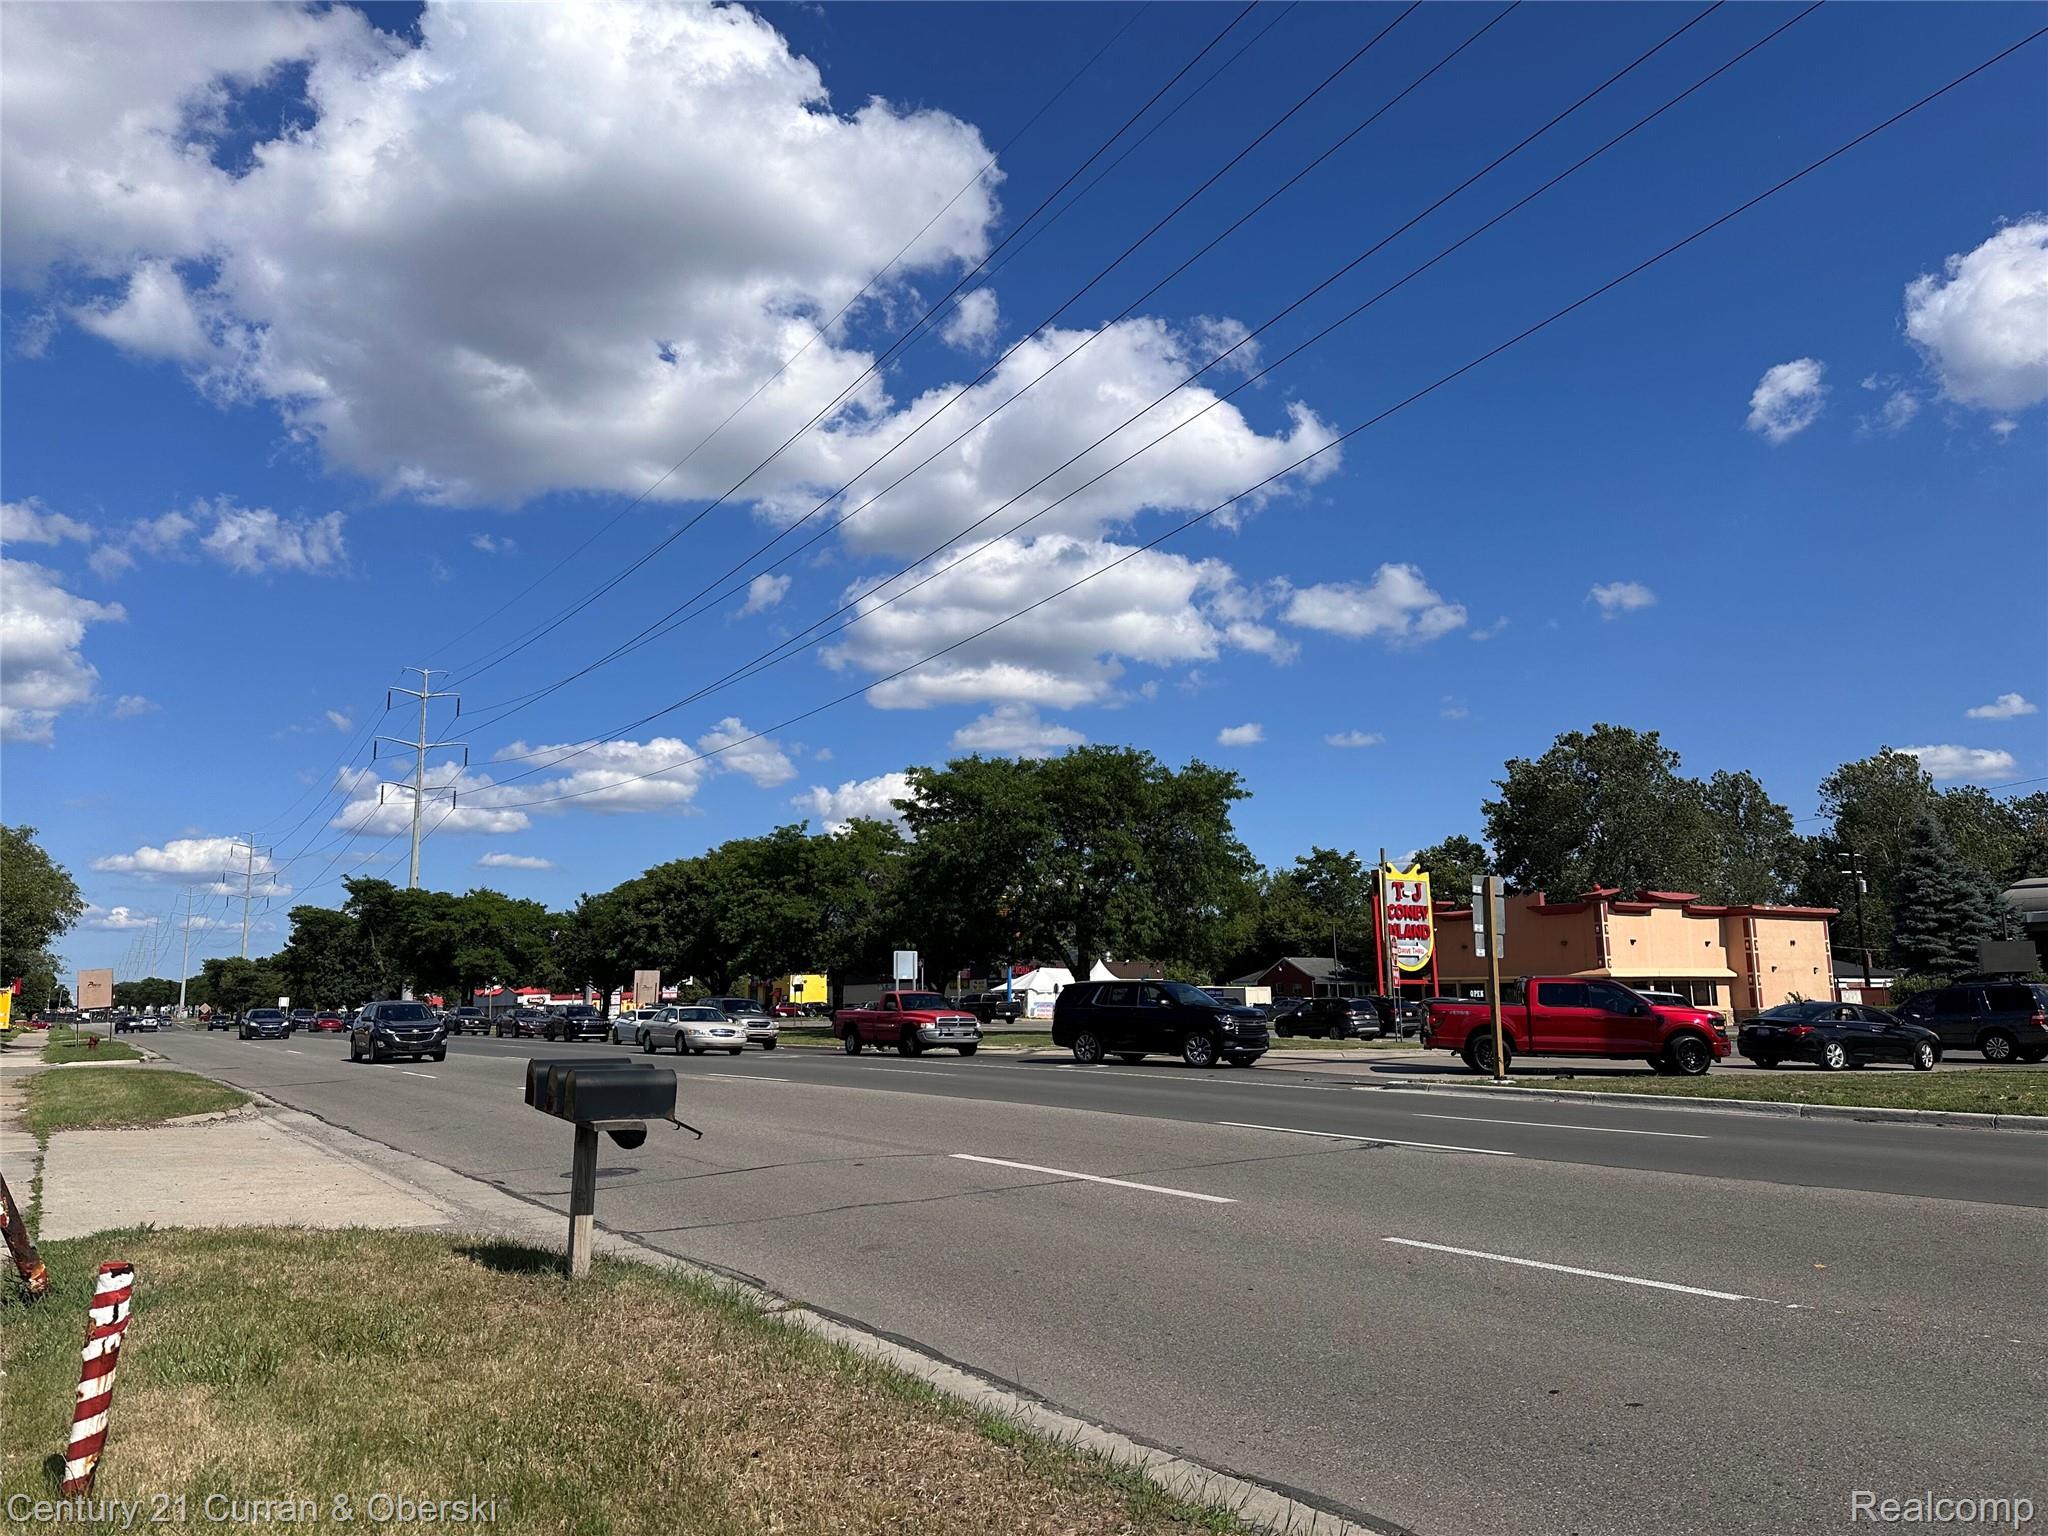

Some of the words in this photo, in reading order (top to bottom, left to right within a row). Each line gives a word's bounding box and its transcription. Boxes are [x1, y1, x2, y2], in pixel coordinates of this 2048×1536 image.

[1387, 904, 1428, 921] CONEY
[1388, 924, 1430, 940] ISLAND
[1470, 989, 1484, 997] OPEN
